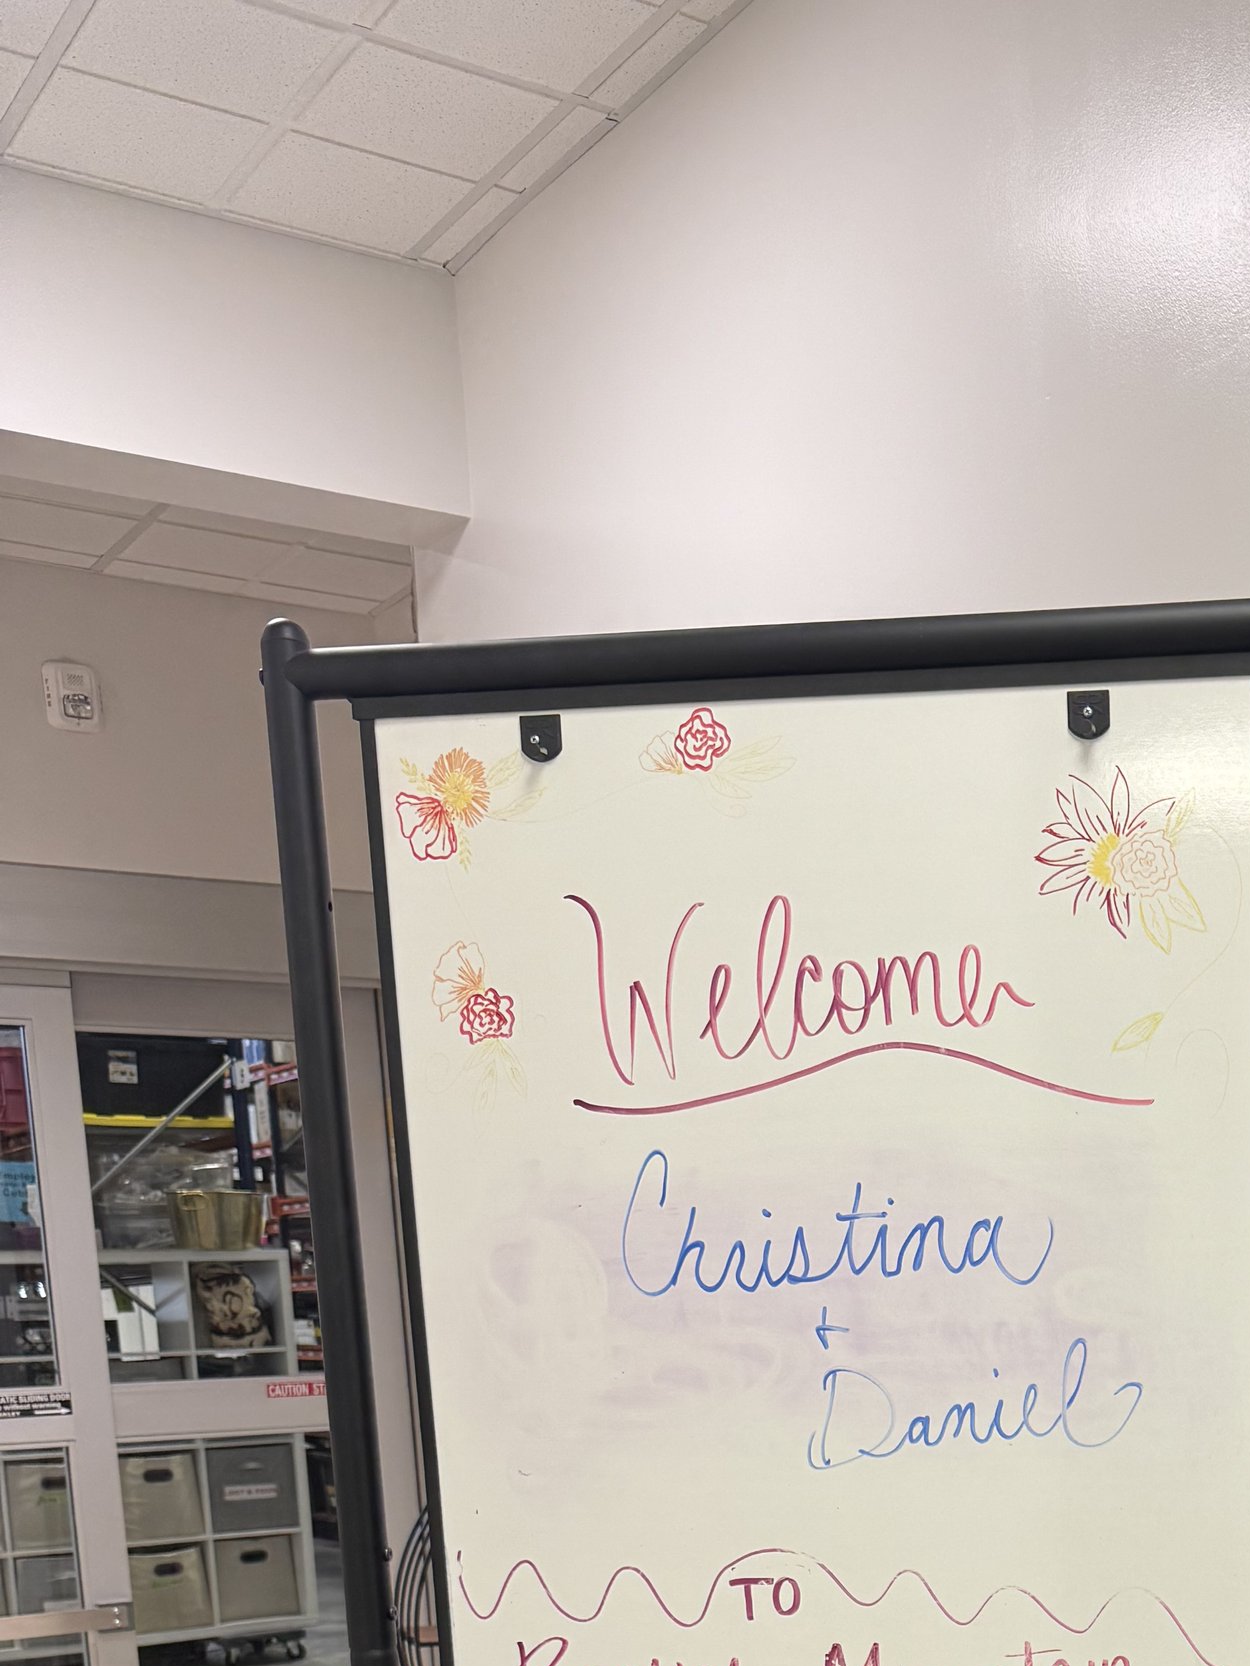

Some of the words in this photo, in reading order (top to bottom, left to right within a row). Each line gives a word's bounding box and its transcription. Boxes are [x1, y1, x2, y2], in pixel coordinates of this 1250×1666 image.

[563, 893, 1036, 1086] Welcome
[621, 1149, 1054, 1297] Christina
[268, 1383, 310, 1398] CAUTION
[808, 1338, 1143, 1470] Daniel
[729, 1577, 801, 1622] TO
